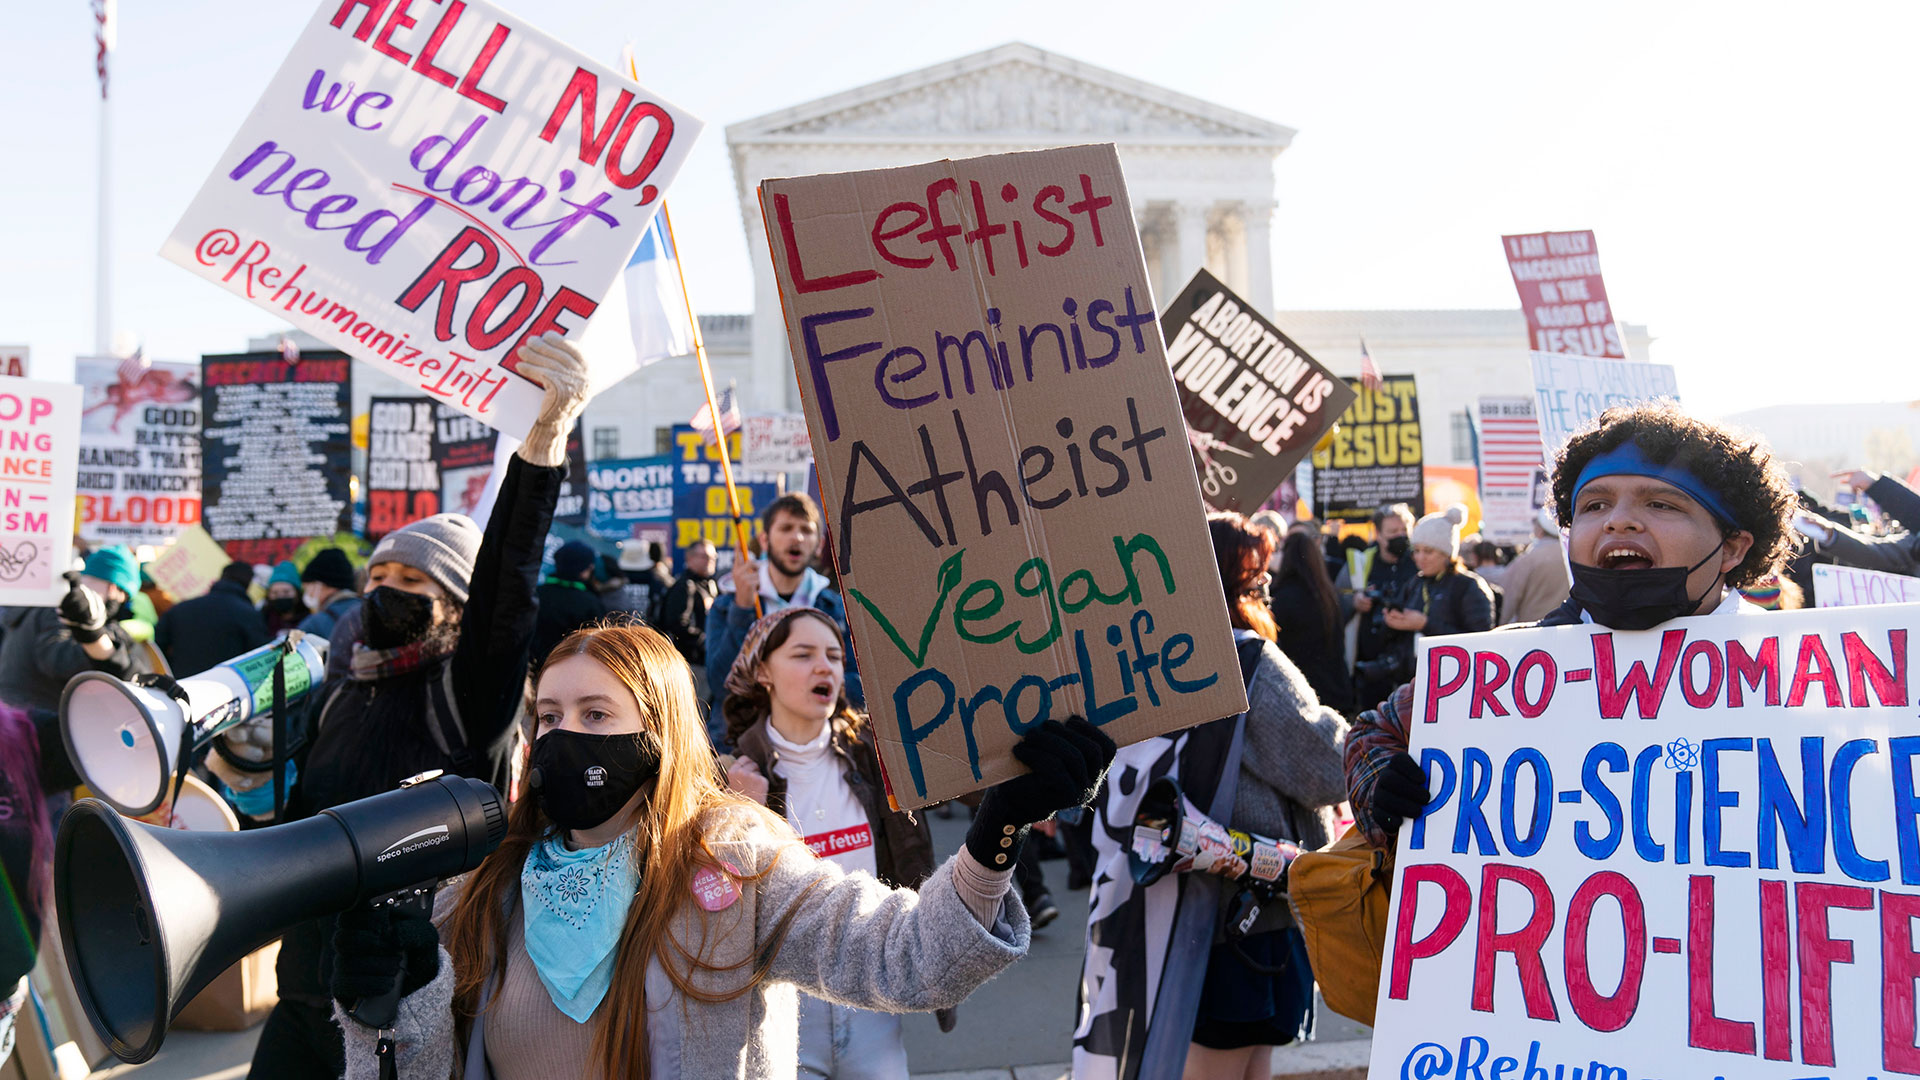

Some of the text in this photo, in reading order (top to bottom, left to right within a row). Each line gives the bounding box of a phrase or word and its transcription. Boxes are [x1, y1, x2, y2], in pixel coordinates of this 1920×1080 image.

[302, 69, 621, 267] we don't
[538, 66, 675, 207] NO,
[228, 140, 600, 390] need ROE
[773, 174, 1113, 295] Leftist
[145, 407, 196, 426] GOD
[801, 284, 1156, 443] Feminist
[1168, 321, 1307, 456] VIOLENCE
[1190, 291, 1334, 413] ABORTION IS
[80, 494, 202, 524] BLOOD
[838, 397, 1167, 576] Atheist
[848, 532, 1176, 669] Vegan
[892, 609, 1218, 799] Pro-Life
[1424, 628, 1920, 723] PRO-WOMAN
[377, 832, 450, 862] speco technologies
[829, 831, 869, 850] fetus
